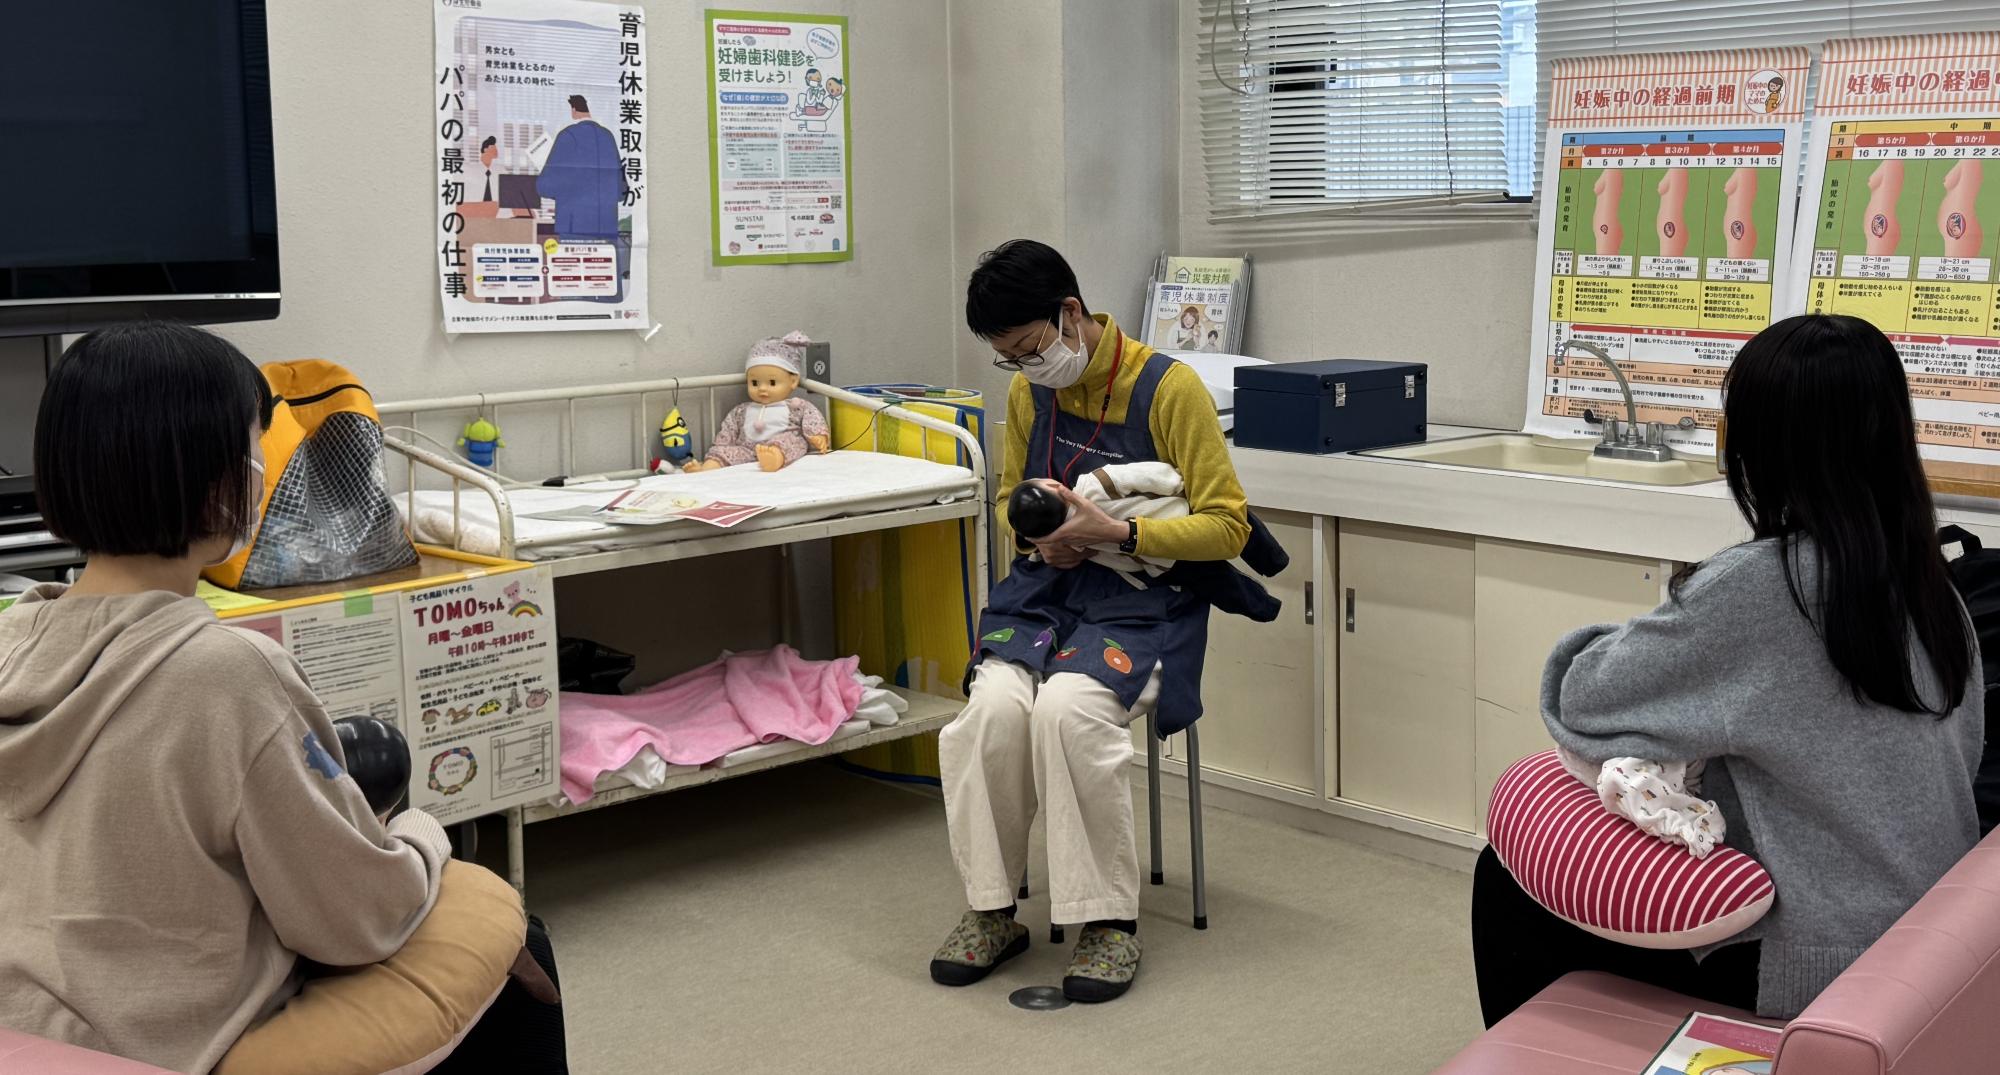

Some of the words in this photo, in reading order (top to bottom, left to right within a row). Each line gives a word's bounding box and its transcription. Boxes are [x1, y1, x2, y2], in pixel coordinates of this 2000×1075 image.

[485, 45, 516, 56] 男女とも
[718, 46, 815, 67] 妊婦歯科健診を
[485, 60, 555, 73] 育児休業をとるのが
[485, 74, 555, 86] あたりまえの時代に
[718, 68, 792, 84] 受けましょう!
[1846, 69, 2000, 95] 妊娠中の経過
[1573, 83, 1736, 110] 妊娠中の経過前期
[617, 12, 645, 208] 育児休業取得が
[1877, 136, 1907, 146] 第5か月
[1955, 135, 1986, 144] 第6か月
[1858, 149, 1869, 157] 16
[1878, 149, 1888, 157] 17
[1896, 149, 1907, 157] 18
[1914, 149, 1925, 157] 19
[1934, 148, 1947, 157] 20
[1954, 148, 1966, 156] 21
[1972, 148, 1986, 156] 22
[1587, 158, 1592, 167] 4
[1633, 157, 1639, 166] 7
[1649, 157, 1656, 166] 8
[1679, 157, 1689, 166] 10
[1696, 157, 1706, 166] 11
[1716, 157, 1727, 166] 12
[1733, 157, 1743, 166] 13
[1750, 157, 1760, 166] 14
[1766, 157, 1777, 166] 15
[440, 64, 468, 299] パパの最初の仕事
[1192, 273, 1231, 285] 災害対策
[1160, 290, 1229, 304] 育児休業制度
[1056, 436, 1065, 444] The
[413, 597, 505, 628] TOMOちゃん
[428, 620, 495, 646] 月曜～金曜日
